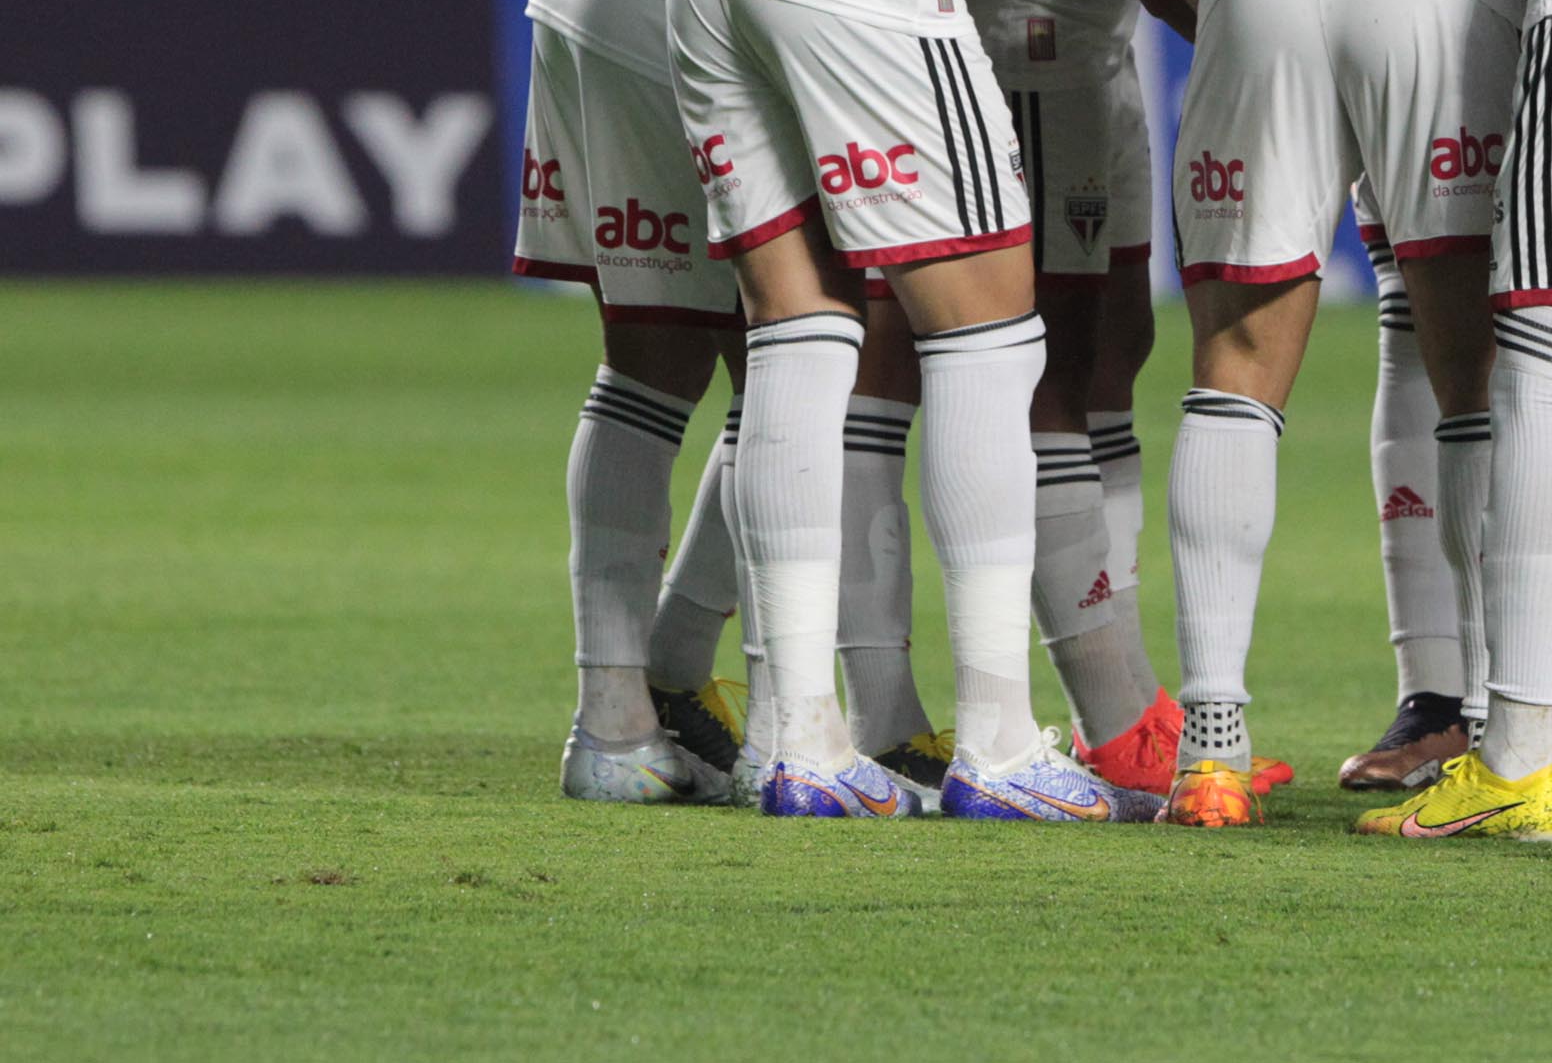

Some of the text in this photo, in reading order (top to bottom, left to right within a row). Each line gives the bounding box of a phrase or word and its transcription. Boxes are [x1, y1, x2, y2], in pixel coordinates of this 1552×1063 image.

[522, 148, 566, 202] bc
[817, 141, 920, 195] abc
[1189, 150, 1245, 203] abc
[1430, 125, 1505, 181] abc
[1432, 185, 1450, 198] da
[595, 197, 691, 255] abc
[613, 257, 693, 274] construção
